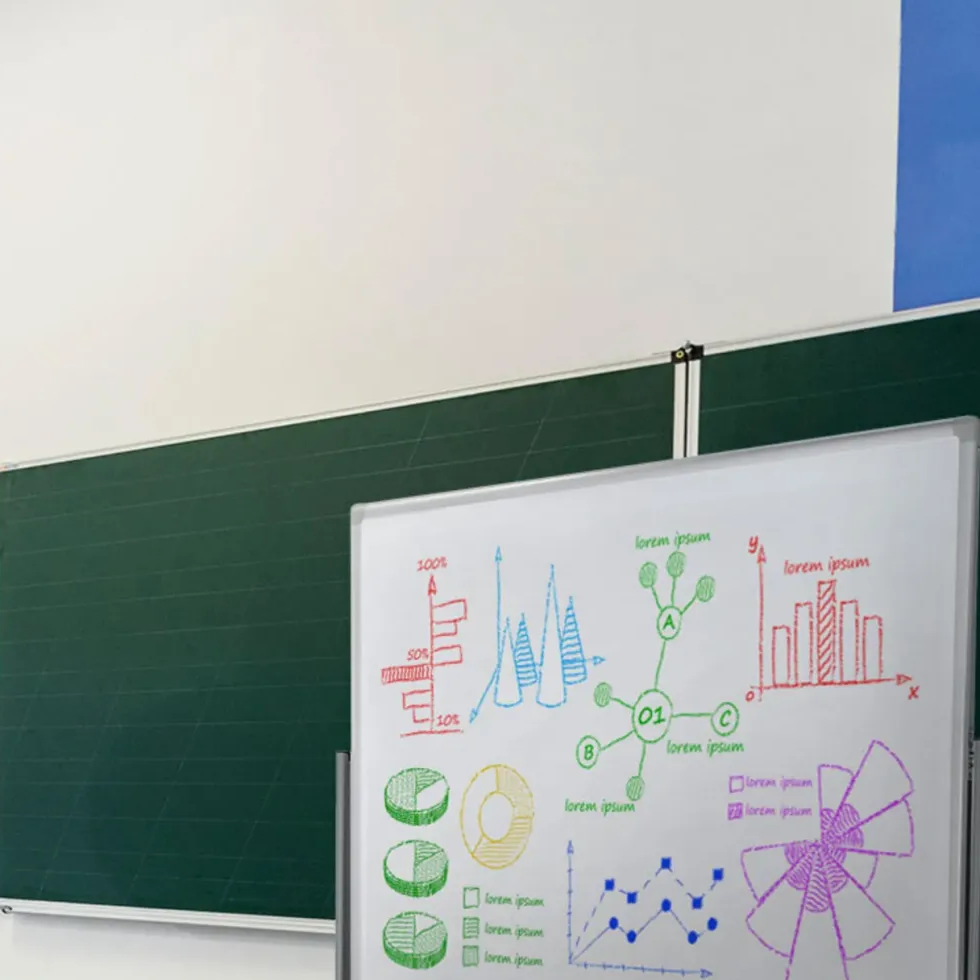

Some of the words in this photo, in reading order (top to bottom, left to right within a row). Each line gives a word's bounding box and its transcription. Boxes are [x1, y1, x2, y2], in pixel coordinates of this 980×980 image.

[634, 535, 670, 550] lorem
[674, 531, 711, 551] ipsum
[417, 557, 448, 572] 100%
[783, 560, 823, 575] lorem
[828, 556, 870, 576] ipsum
[662, 614, 676, 630] A
[407, 648, 430, 662] 50%
[436, 714, 460, 727] 10%
[638, 706, 666, 725] 01
[720, 709, 732, 728] C
[583, 743, 594, 760] B
[666, 740, 702, 754] lorem
[707, 739, 745, 757] ipsum
[745, 776, 777, 788] lorem
[780, 776, 813, 792] ipsum
[565, 799, 597, 812] lorem
[601, 799, 636, 816] ipsum
[745, 804, 776, 816] lorem
[780, 804, 813, 820] ipsum
[484, 892, 512, 906] lorem
[515, 894, 545, 909] ipsum
[484, 922, 512, 936] lorem
[515, 923, 544, 940] ipsum
[484, 951, 511, 965] lorem
[514, 953, 543, 968] ipsum
